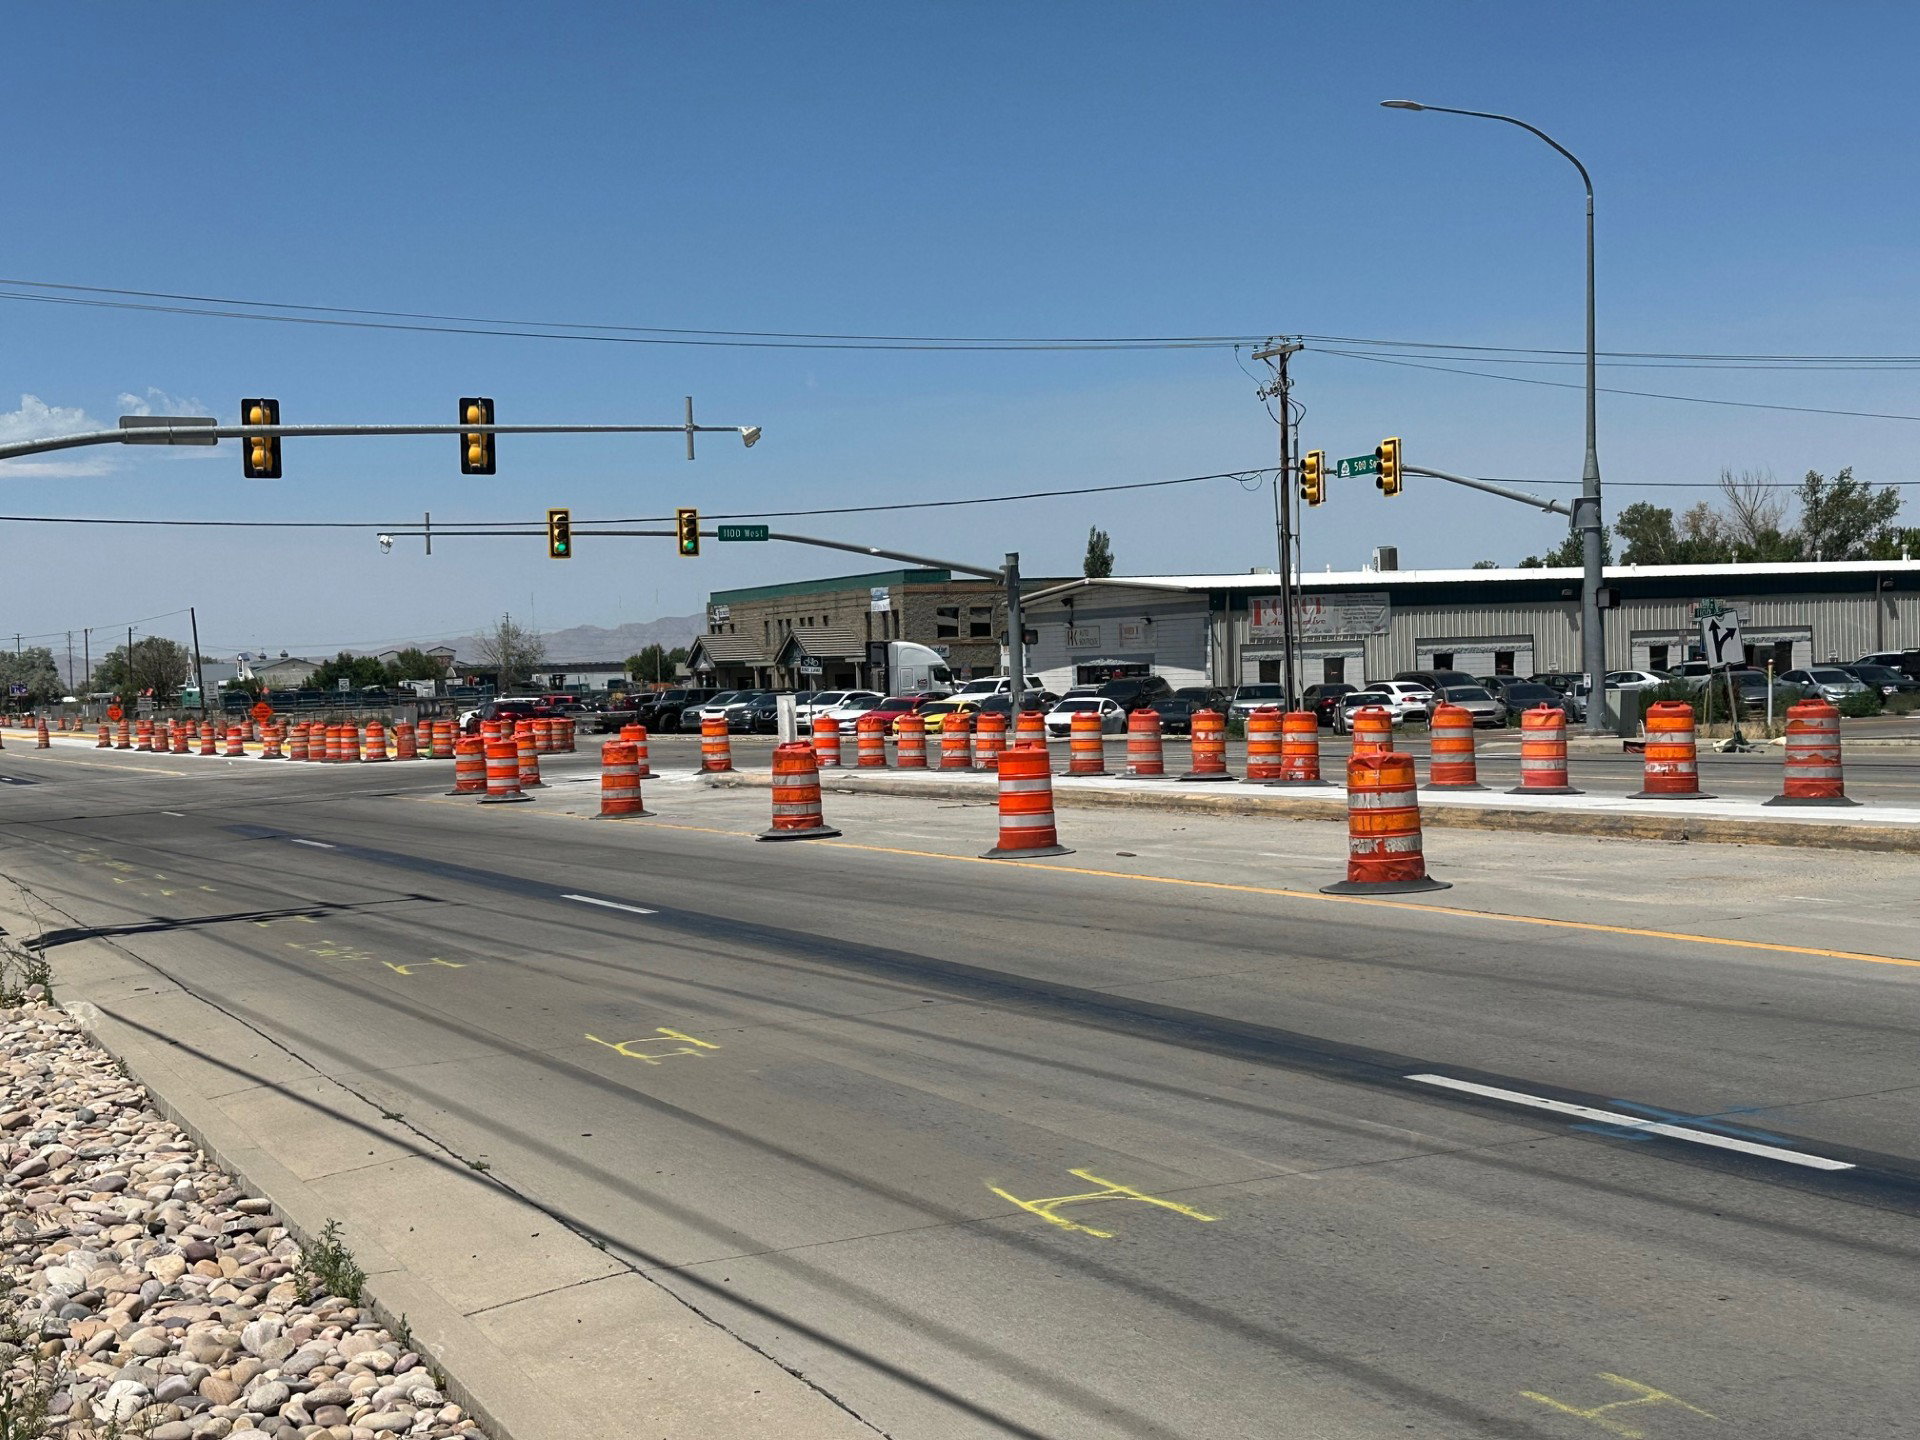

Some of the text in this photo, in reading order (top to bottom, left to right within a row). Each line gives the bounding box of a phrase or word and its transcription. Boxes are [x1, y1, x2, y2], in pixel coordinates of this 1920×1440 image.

[1354, 460, 1367, 472] 500
[723, 529, 764, 538] 1100 West
